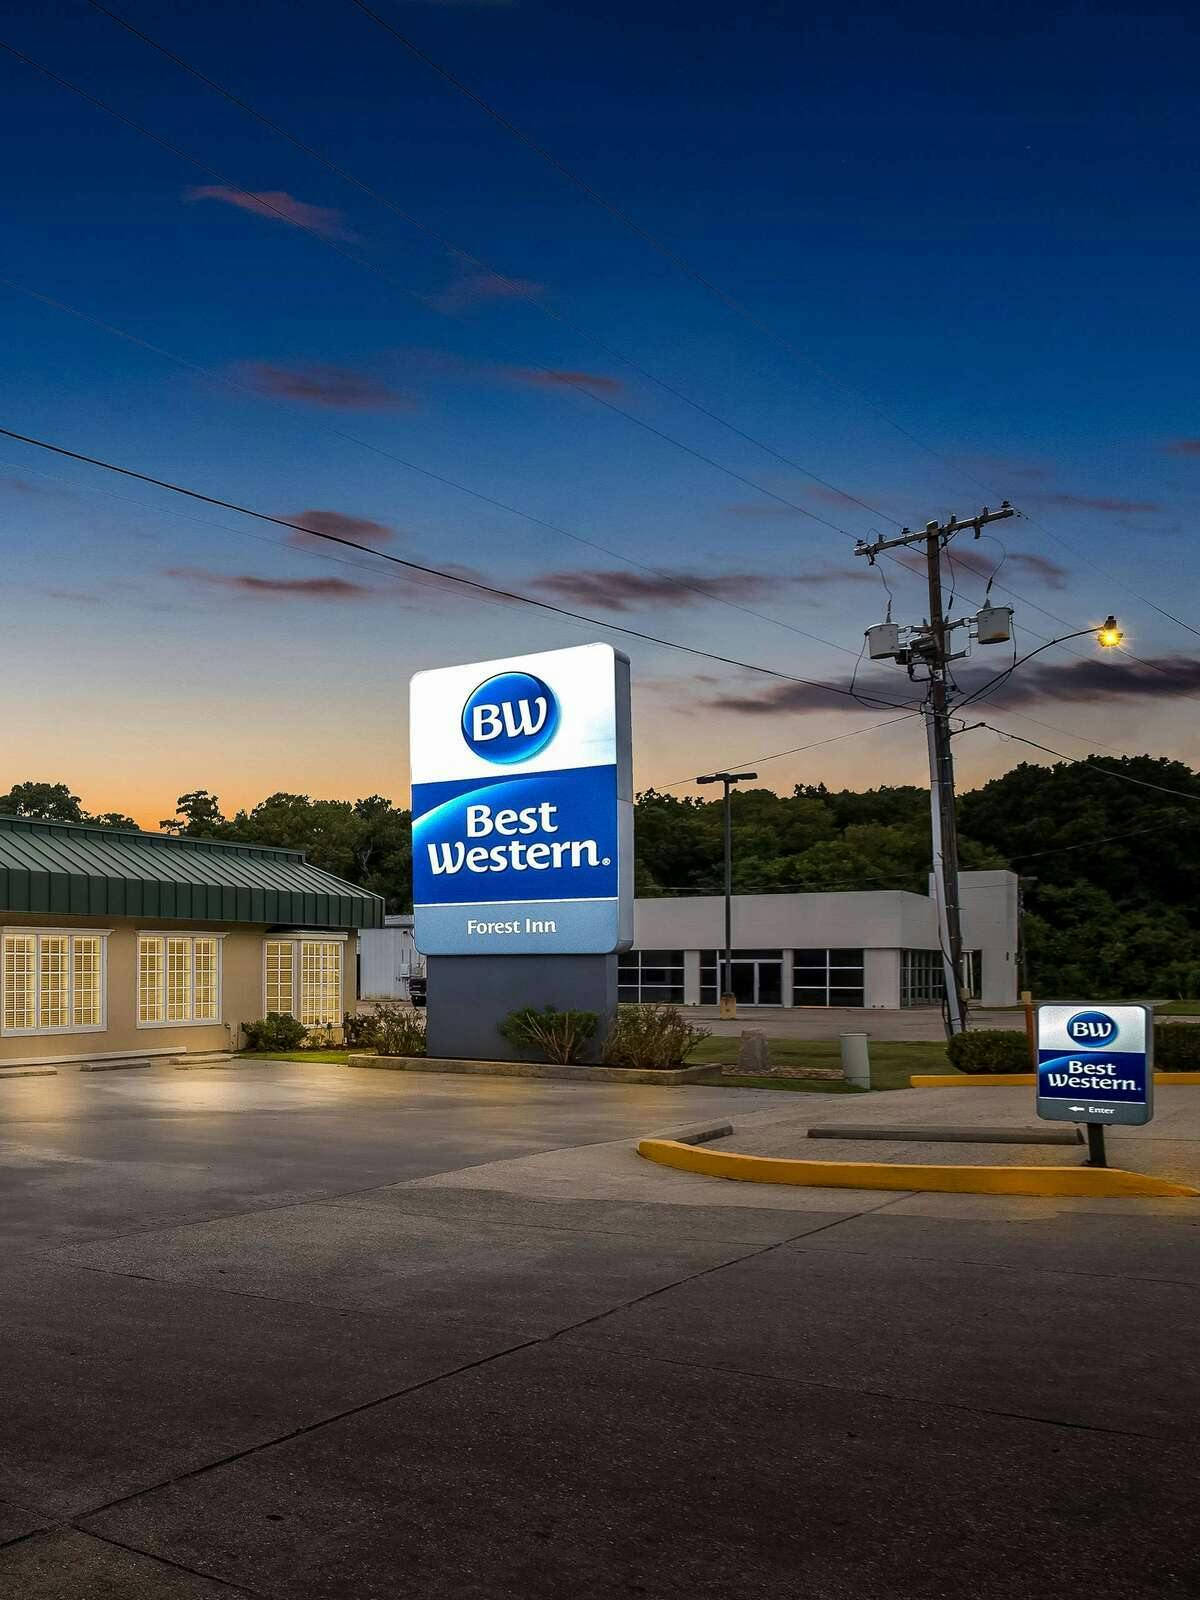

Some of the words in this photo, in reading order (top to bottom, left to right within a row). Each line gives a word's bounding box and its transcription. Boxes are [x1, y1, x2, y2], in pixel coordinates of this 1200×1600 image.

[473, 696, 548, 741] BW
[466, 802, 559, 838] Best
[467, 919, 521, 935] Forest
[525, 918, 557, 934] Inn
[1072, 1021, 1112, 1038] BW
[1068, 1060, 1117, 1076] Best
[1088, 1106, 1116, 1114] Enter
